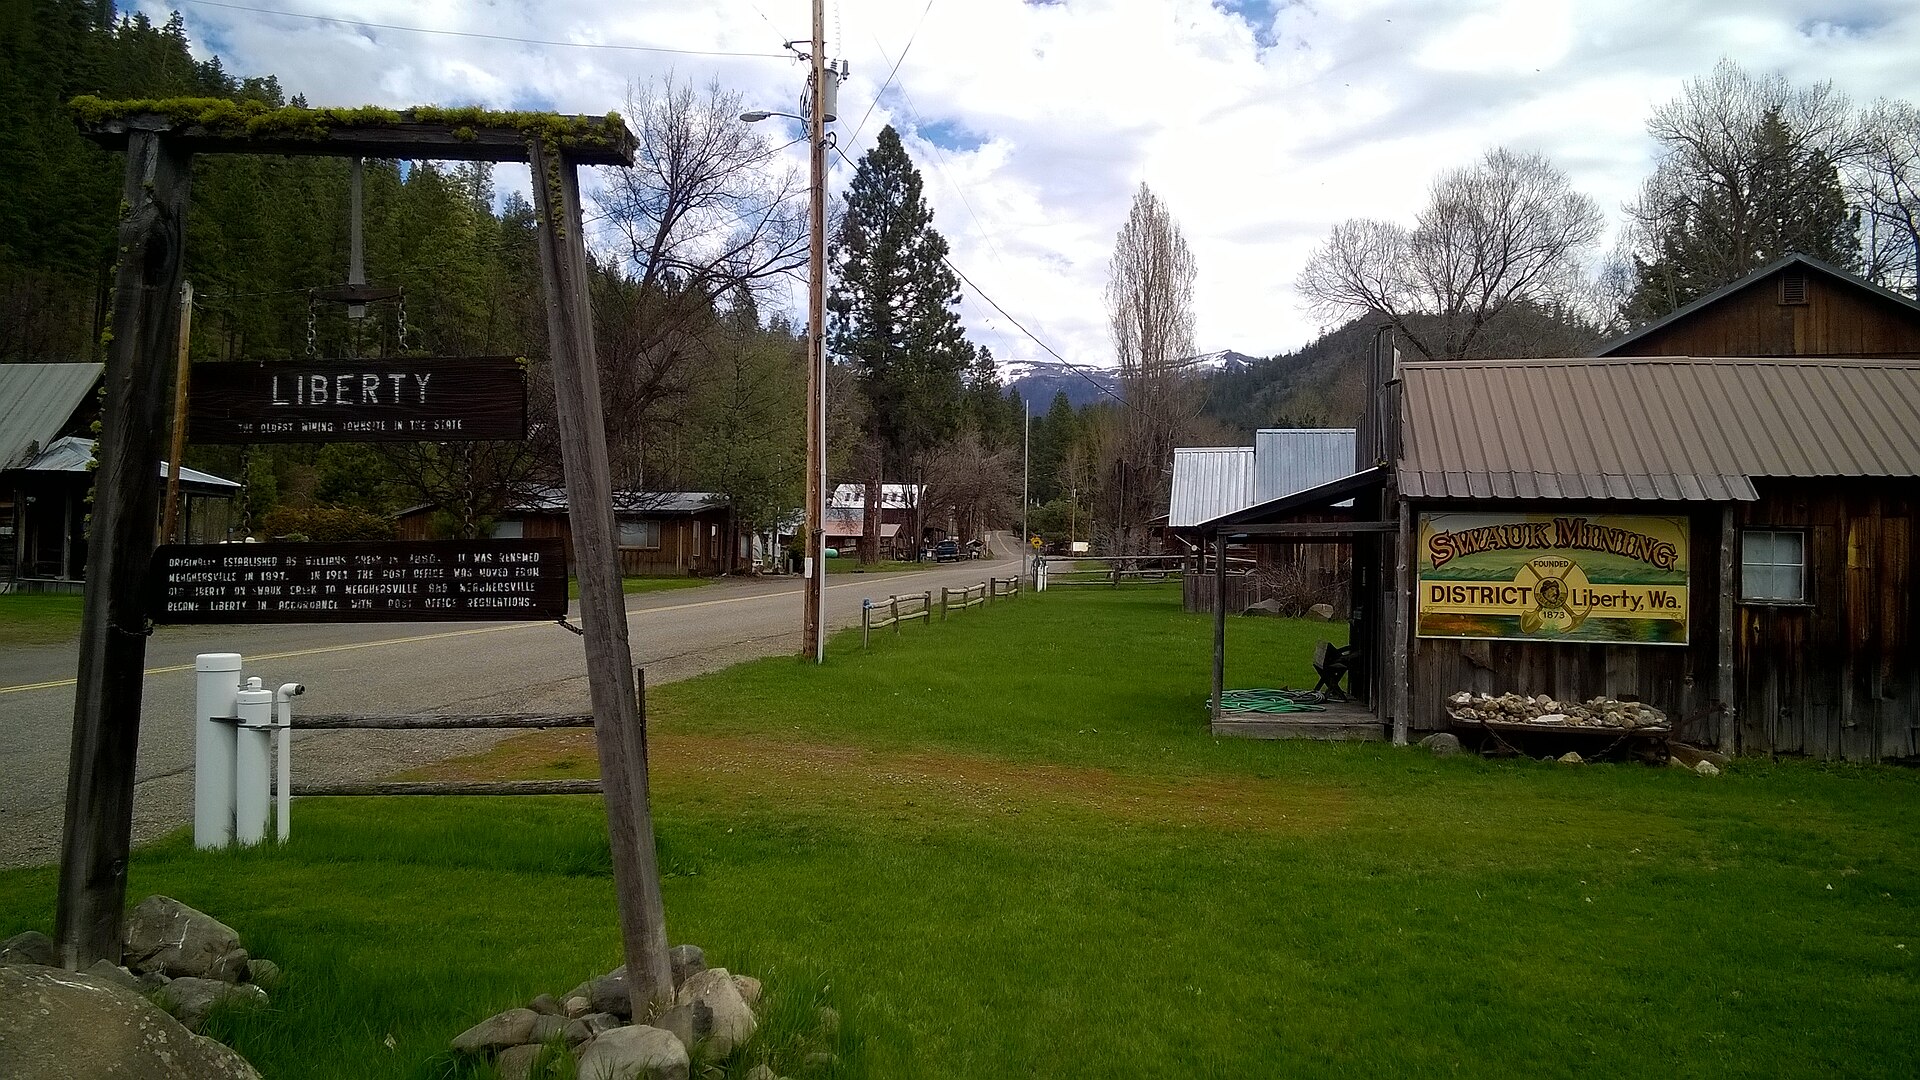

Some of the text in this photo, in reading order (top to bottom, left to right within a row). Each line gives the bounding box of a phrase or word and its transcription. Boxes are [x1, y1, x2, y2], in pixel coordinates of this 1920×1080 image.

[272, 373, 431, 405] LIBERTY
[261, 422, 293, 433] OLDEST
[301, 422, 333, 432] MINING
[342, 421, 386, 431] TOWNSITE
[394, 420, 403, 430] IN
[409, 420, 426, 430] THE
[434, 419, 462, 430] STATE
[1429, 517, 1678, 571] SWAUK MINING
[224, 556, 278, 567] ESTABLISHED
[286, 556, 297, 567] AS
[474, 552, 492, 563] WAS
[1533, 560, 1569, 568] FOUNDED
[245, 571, 254, 581] IN
[260, 571, 289, 581] 1897.
[310, 570, 320, 580] IN
[357, 569, 374, 579] THE
[383, 569, 407, 579] POST
[413, 568, 444, 578] OFFICE
[454, 567, 472, 578] WAS
[479, 567, 508, 578] MOVED
[192, 586, 226, 597] IBERTY
[325, 584, 336, 595] TO
[345, 583, 417, 595] MEAGHERSVILLE
[210, 601, 247, 611] LIBERTY
[257, 600, 267, 610] IN
[351, 599, 372, 609] WITH
[1431, 585, 1532, 605] DISTRICT
[1573, 588, 1644, 611] Liberty,
[1649, 590, 1682, 609] Wa.
[1543, 611, 1565, 619] 1873
